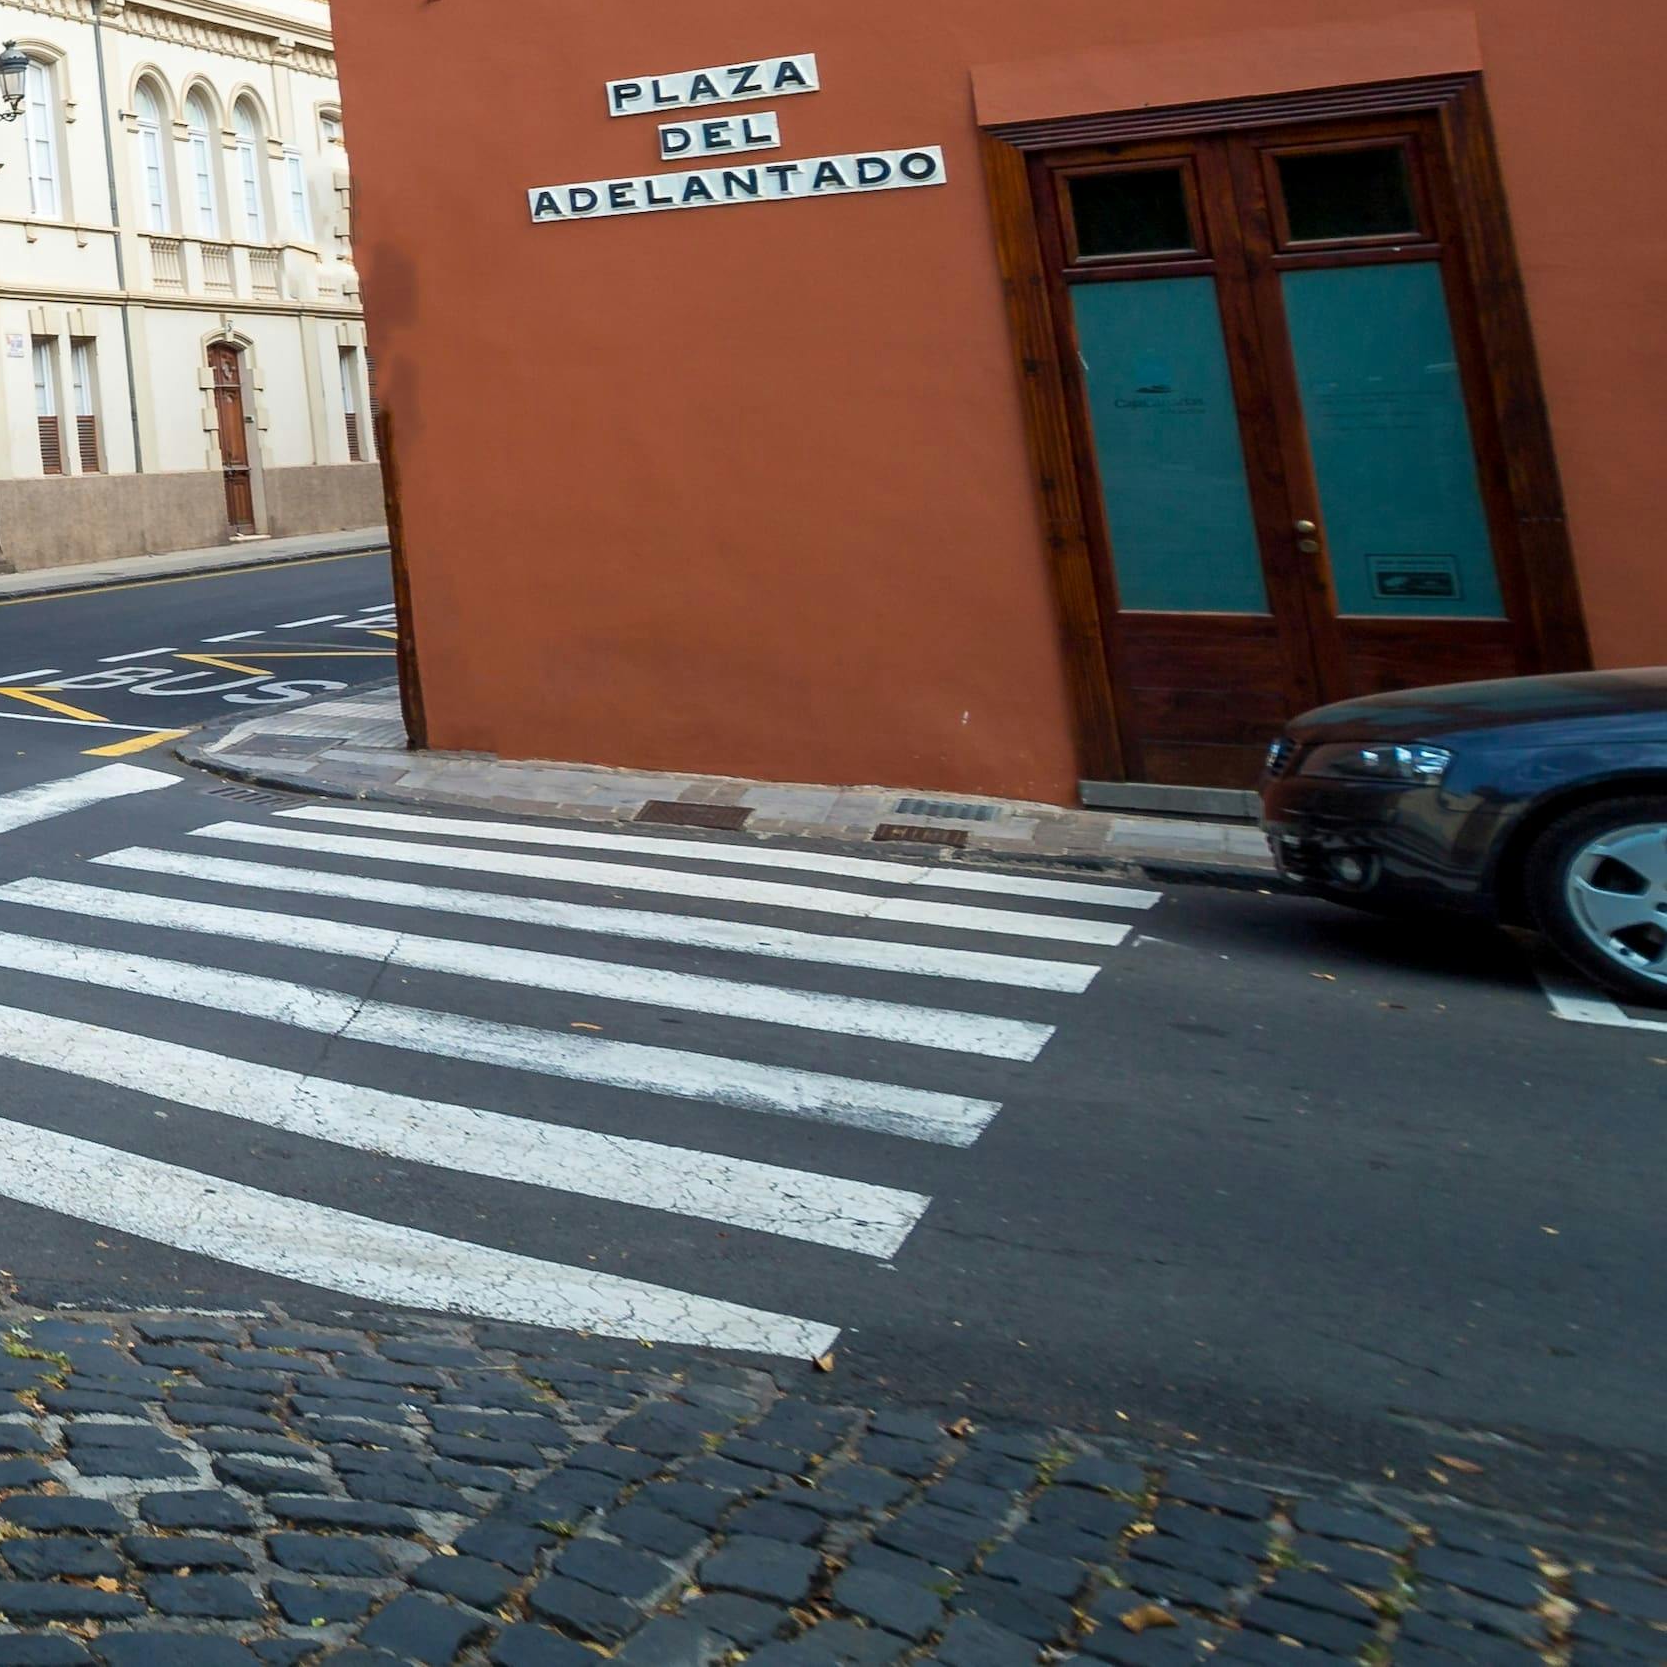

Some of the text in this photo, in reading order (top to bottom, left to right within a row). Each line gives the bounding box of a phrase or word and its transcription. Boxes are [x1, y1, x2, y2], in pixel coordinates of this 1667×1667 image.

[612, 60, 806, 111] PLAZA
[661, 117, 772, 154] DEL
[533, 152, 936, 217] ADELANTADO
[36, 666, 348, 705] BUS
